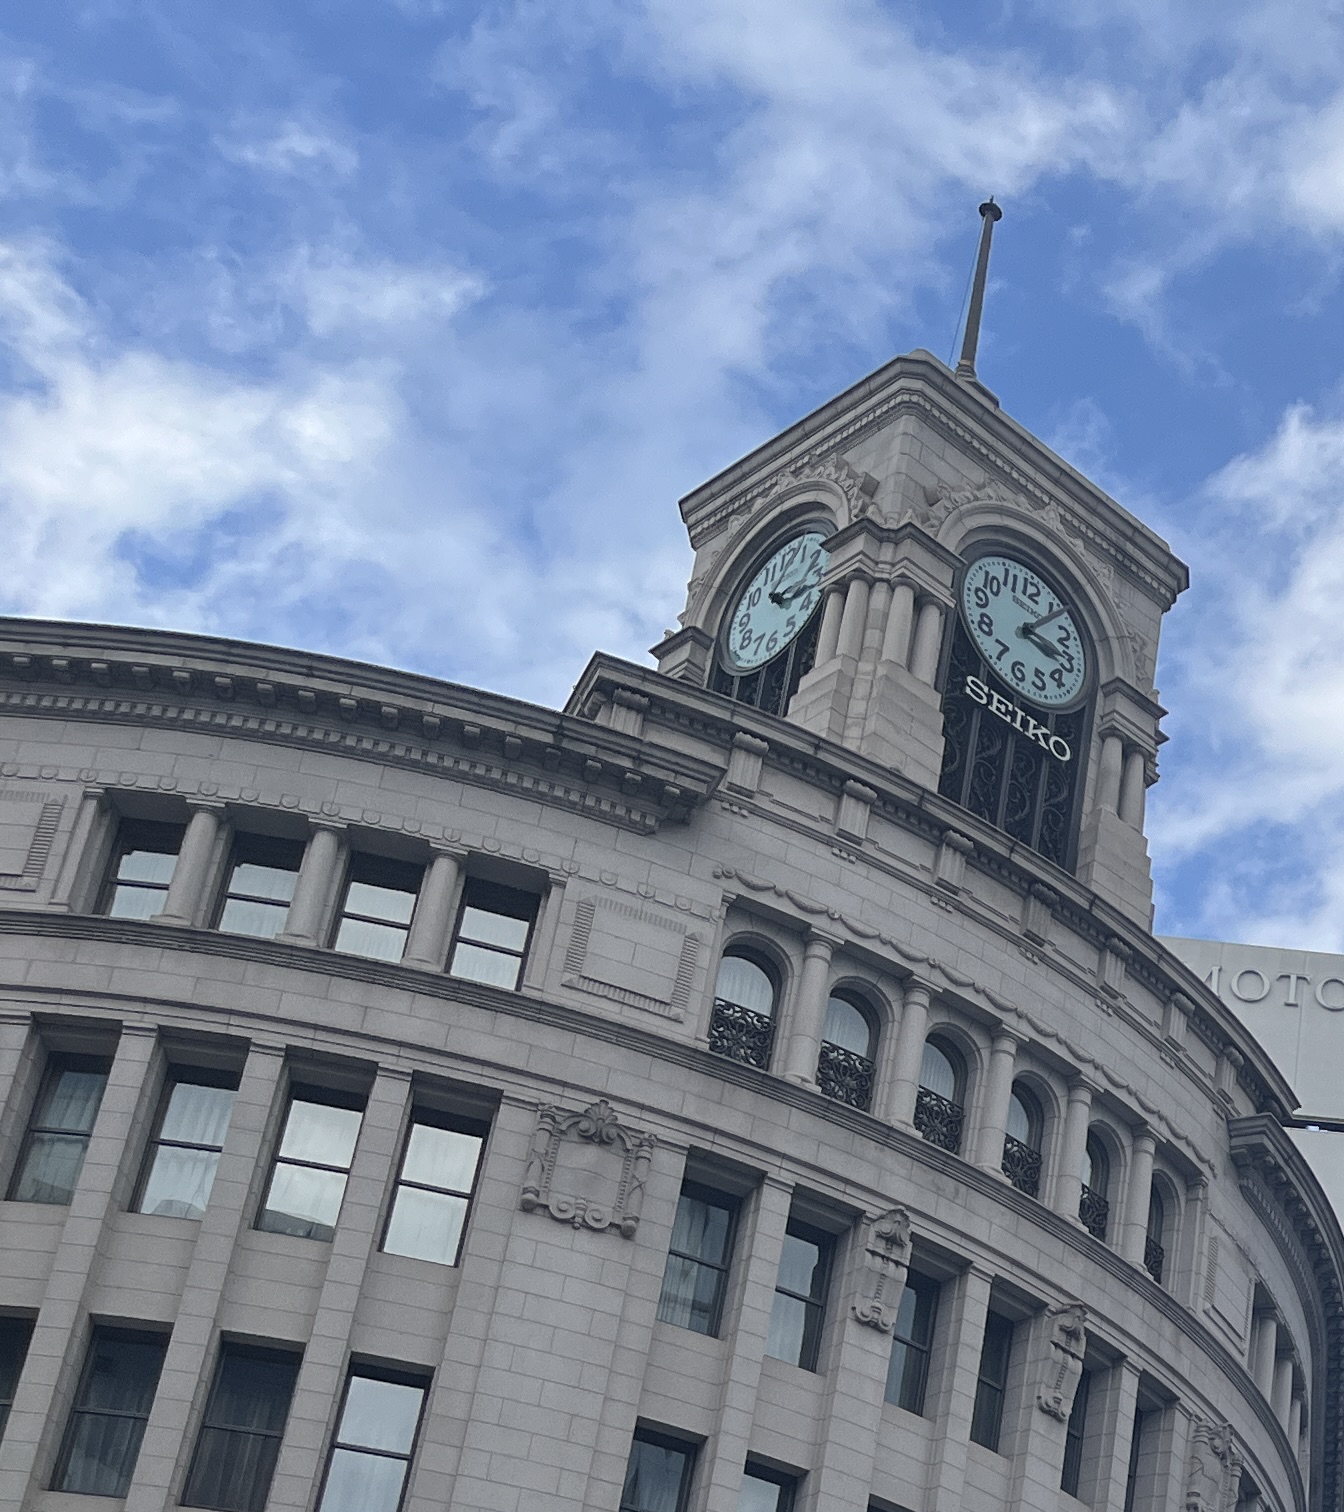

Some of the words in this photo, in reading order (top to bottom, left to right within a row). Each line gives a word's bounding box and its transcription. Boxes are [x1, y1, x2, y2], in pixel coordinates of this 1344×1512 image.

[763, 562, 777, 586] 11
[983, 570, 1001, 597] 10
[1003, 568, 1018, 593] 11
[746, 587, 761, 611] 10
[799, 592, 812, 611] 4
[974, 587, 989, 608] 9
[1021, 577, 1041, 605] 12
[739, 613, 751, 634] 9
[783, 614, 796, 637] 5
[977, 612, 993, 637] 8
[740, 628, 753, 650] 8
[753, 632, 766, 656] 7
[766, 630, 778, 652] 6
[1057, 624, 1071, 649] 2
[995, 638, 1010, 661] 7
[1011, 660, 1026, 682] 6
[1060, 650, 1075, 673] 3
[1031, 667, 1046, 691] 5
[1049, 668, 1066, 689] 4
[966, 675, 1071, 761] SEIKO
